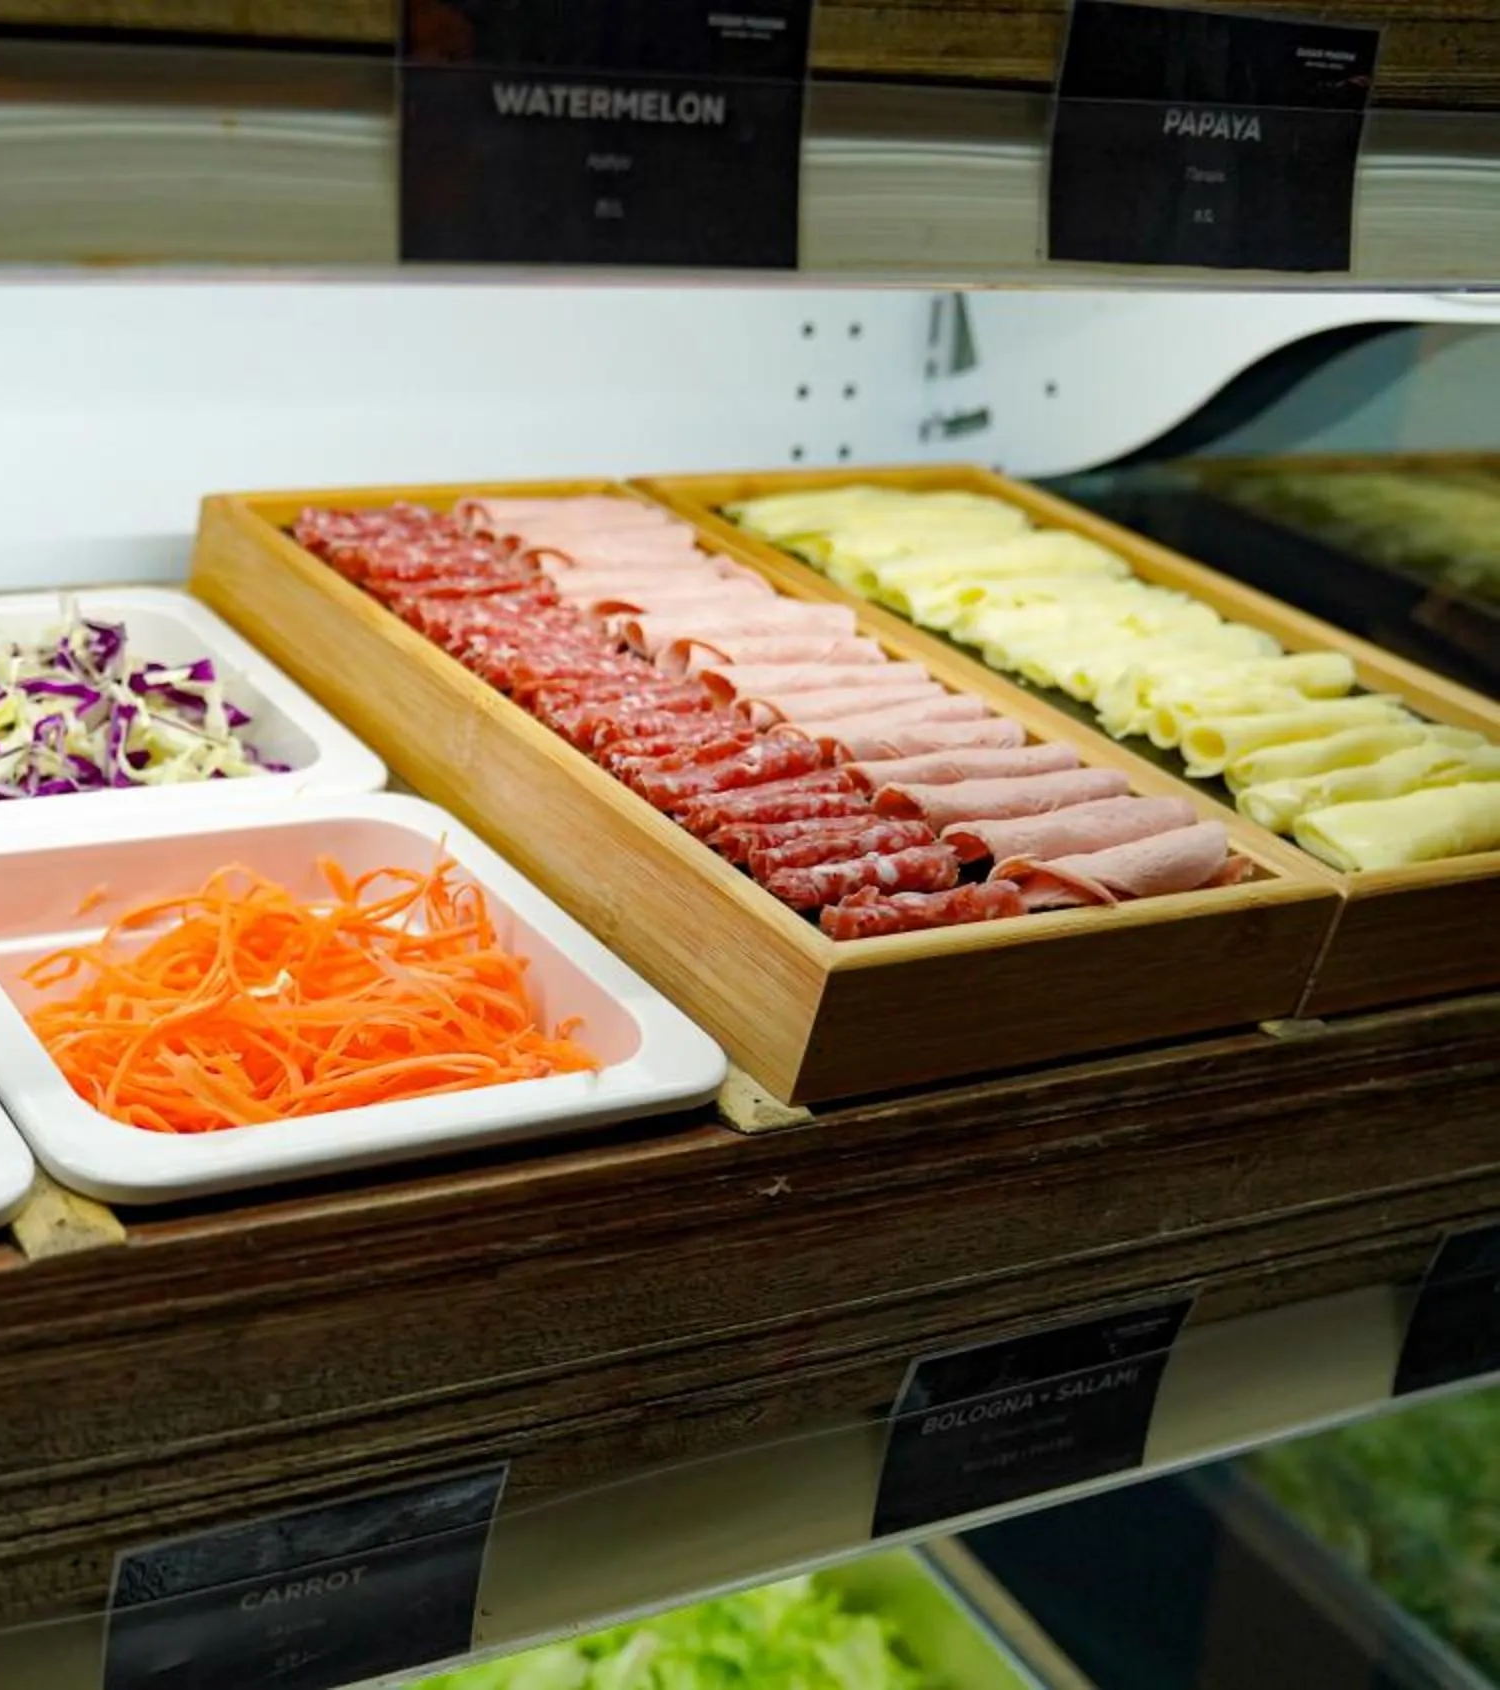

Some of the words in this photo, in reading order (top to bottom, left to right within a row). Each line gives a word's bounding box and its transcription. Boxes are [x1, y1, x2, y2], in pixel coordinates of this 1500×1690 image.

[493, 82, 727, 125] WATERMELON
[1162, 108, 1263, 142] PAPAYA
[920, 1394, 1034, 1436] BOLOGNA
[1055, 1367, 1141, 1402] SALAMI
[239, 1566, 370, 1612] CARROT
